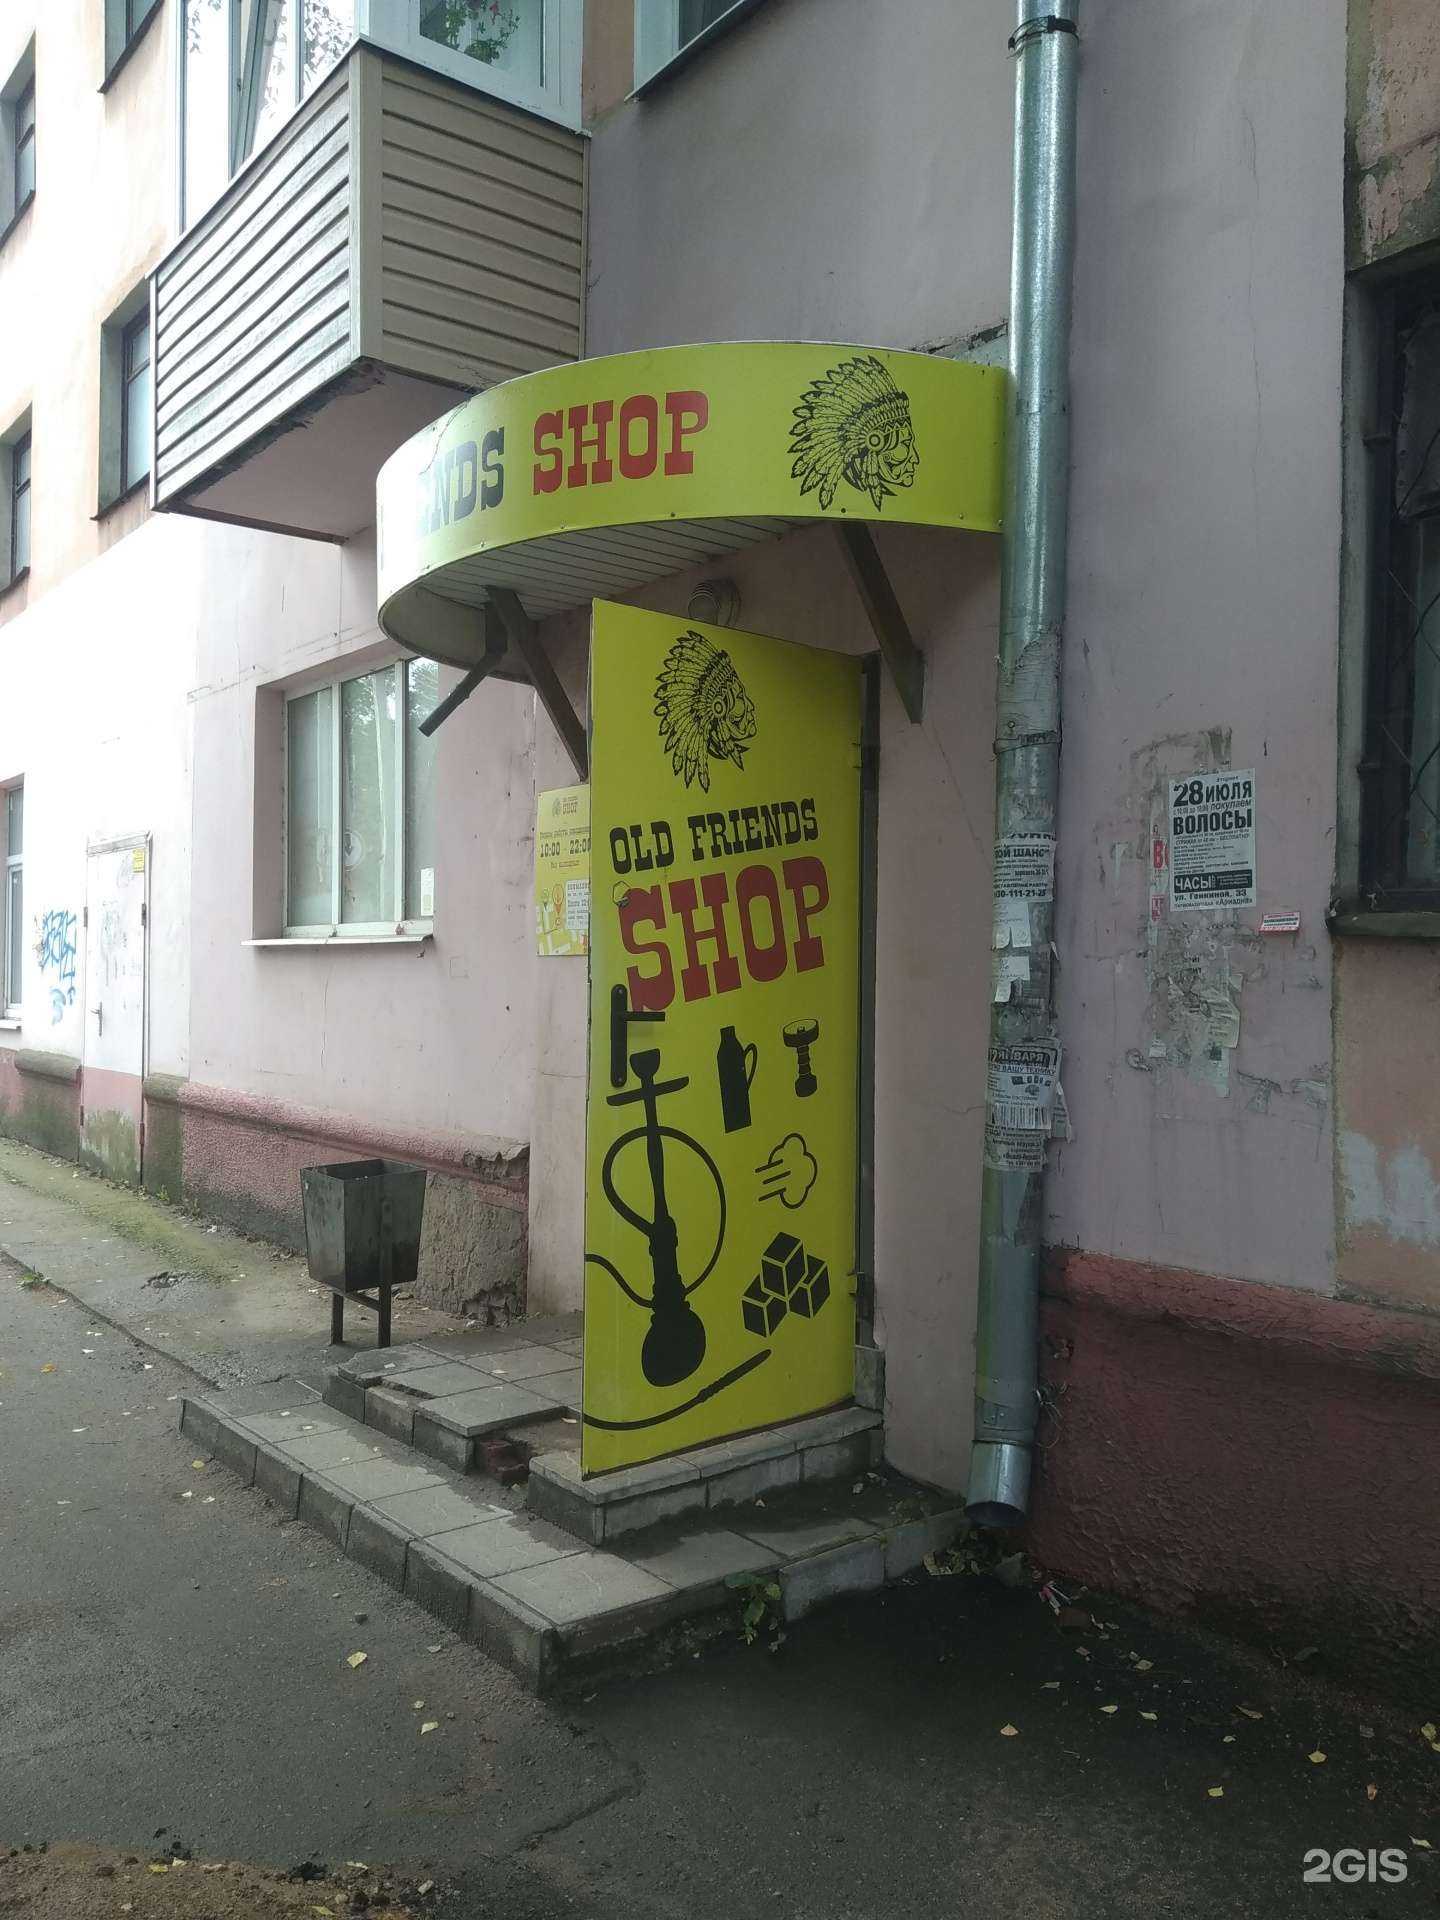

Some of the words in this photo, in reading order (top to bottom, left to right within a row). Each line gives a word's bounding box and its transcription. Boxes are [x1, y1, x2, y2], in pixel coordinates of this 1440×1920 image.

[532, 390, 709, 495] SHOP
[1173, 780, 1204, 808] 28
[1206, 780, 1253, 803] ИЮЛЯ
[609, 820, 675, 875] OLD
[687, 798, 819, 861] FRIENDS
[1173, 809, 1252, 836] ВОЛОСЫ
[540, 841, 561, 858] 10:00
[1175, 874, 1212, 890] ЧАСЫ
[618, 855, 830, 1013] SHOP
